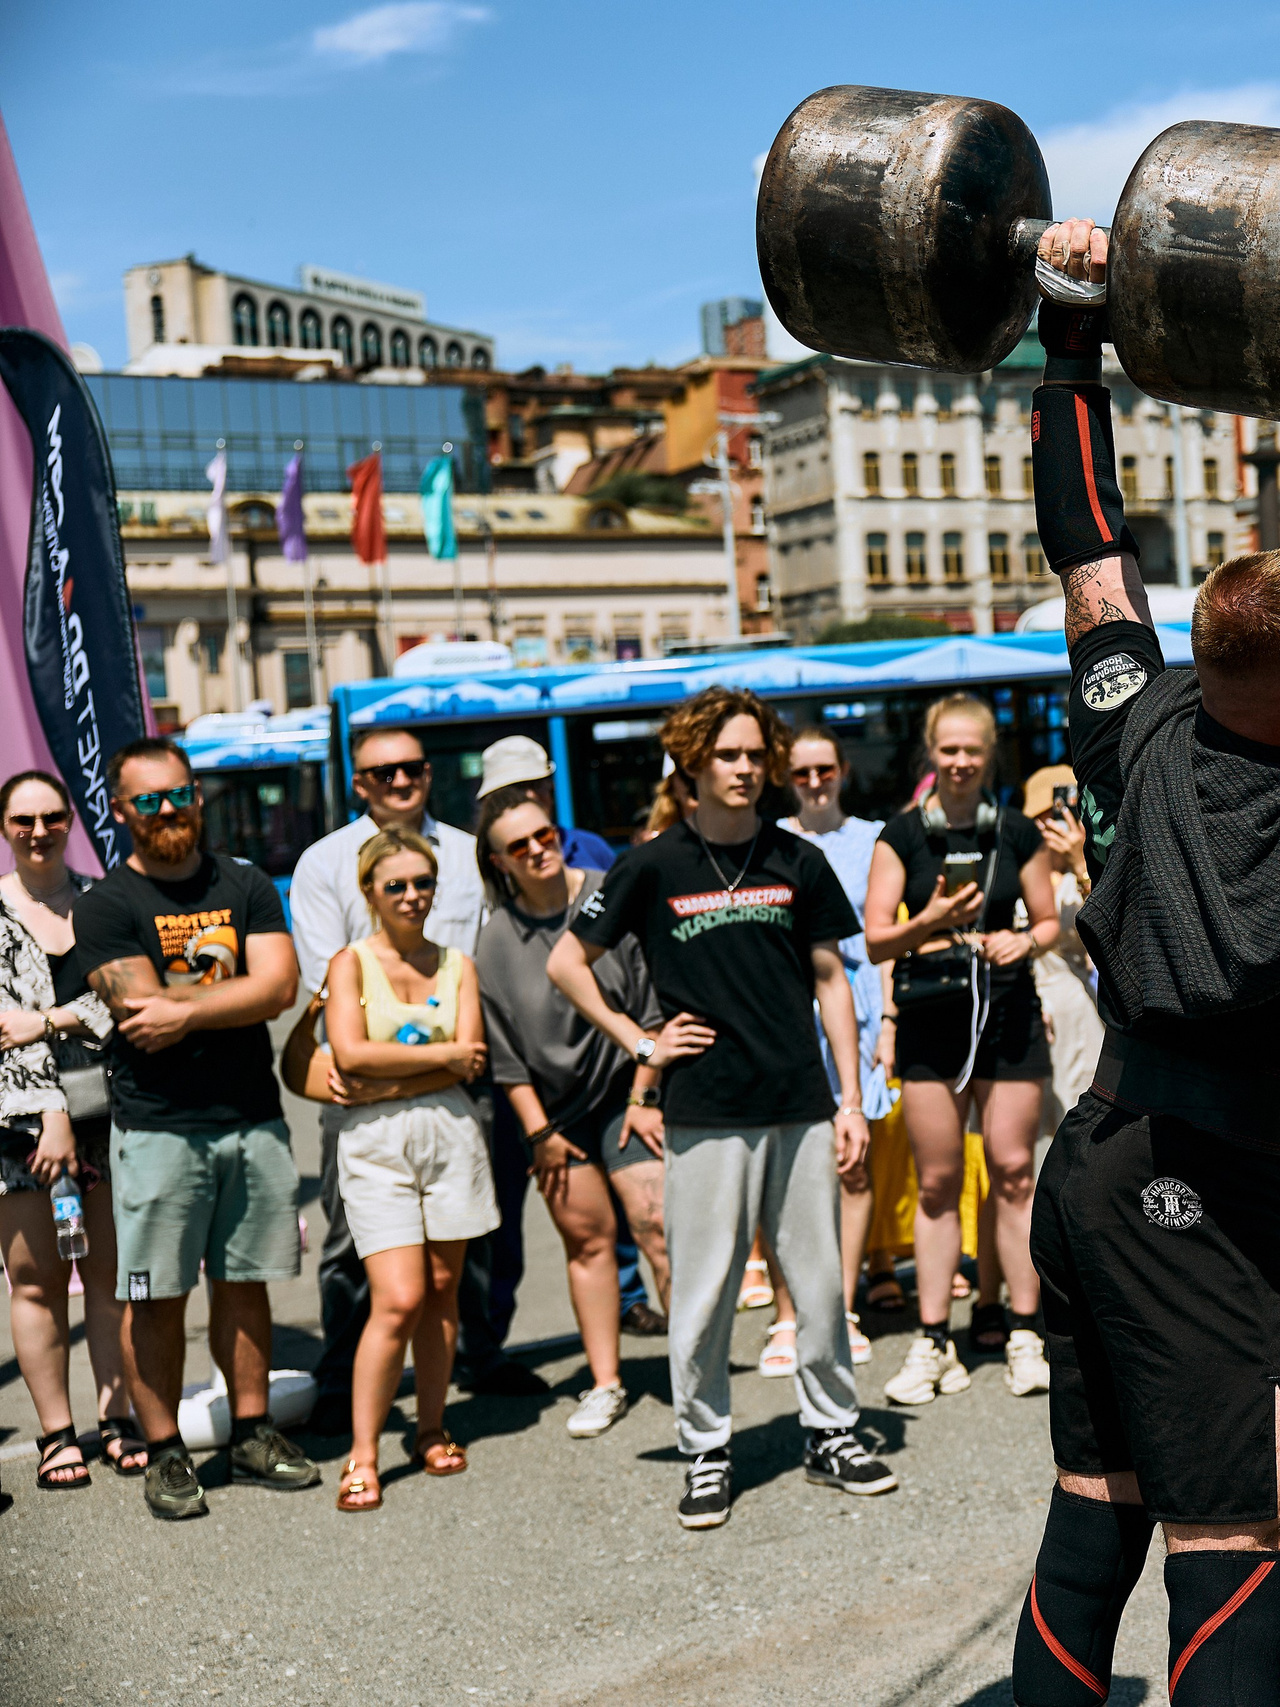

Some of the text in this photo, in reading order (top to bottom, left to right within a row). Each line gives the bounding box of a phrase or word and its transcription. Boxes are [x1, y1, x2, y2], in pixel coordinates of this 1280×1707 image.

[1093, 656, 1123, 672] House
[672, 889, 732, 915] СИЛОВОЙ
[154, 908, 232, 931] PROTEST
[1150, 1181, 1191, 1198] HARDCORE
[1153, 1210, 1195, 1227] TRAINING
